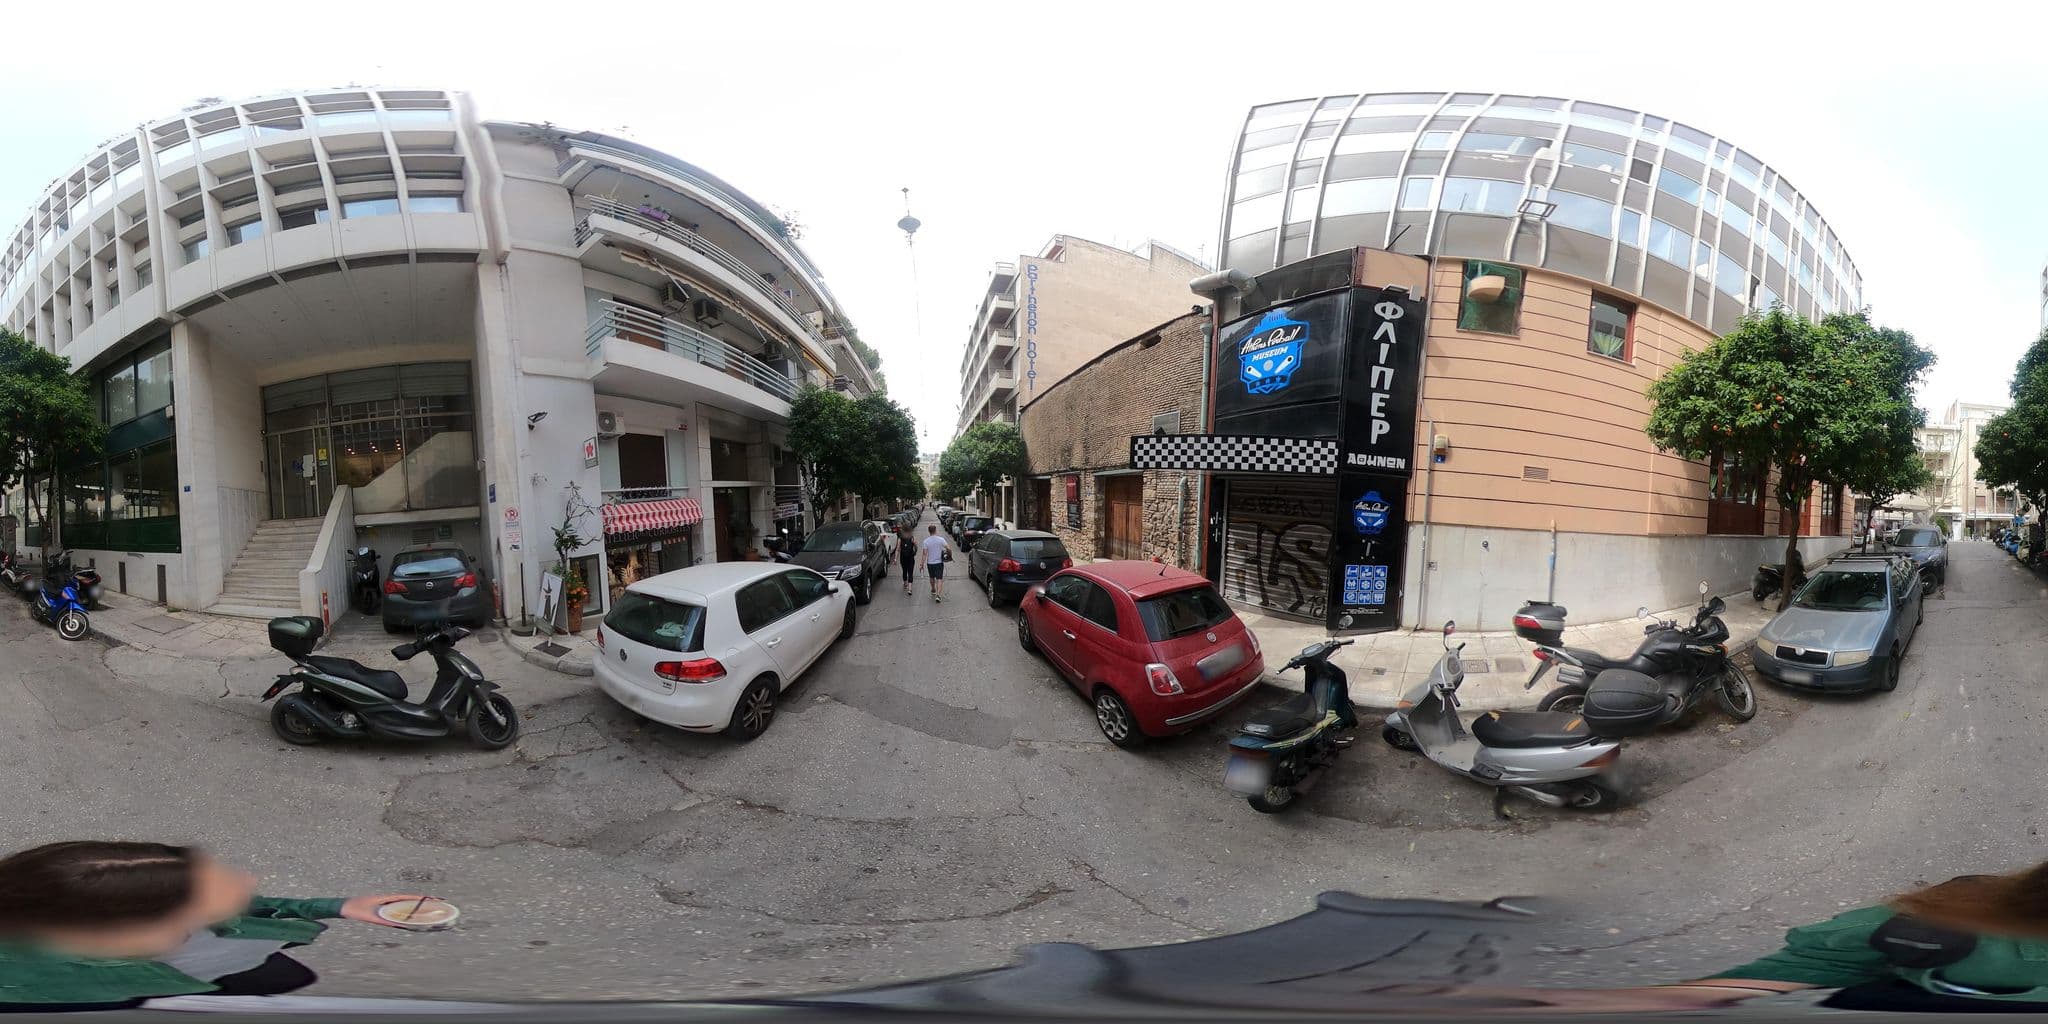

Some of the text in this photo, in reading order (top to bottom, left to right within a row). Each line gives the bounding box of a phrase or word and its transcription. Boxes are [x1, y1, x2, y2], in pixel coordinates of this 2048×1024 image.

[1026, 264, 1038, 391] parthenon hotel
[1251, 345, 1289, 362] MUSEUM
[1371, 301, 1405, 445] ΦΛΙΠΕΡ
